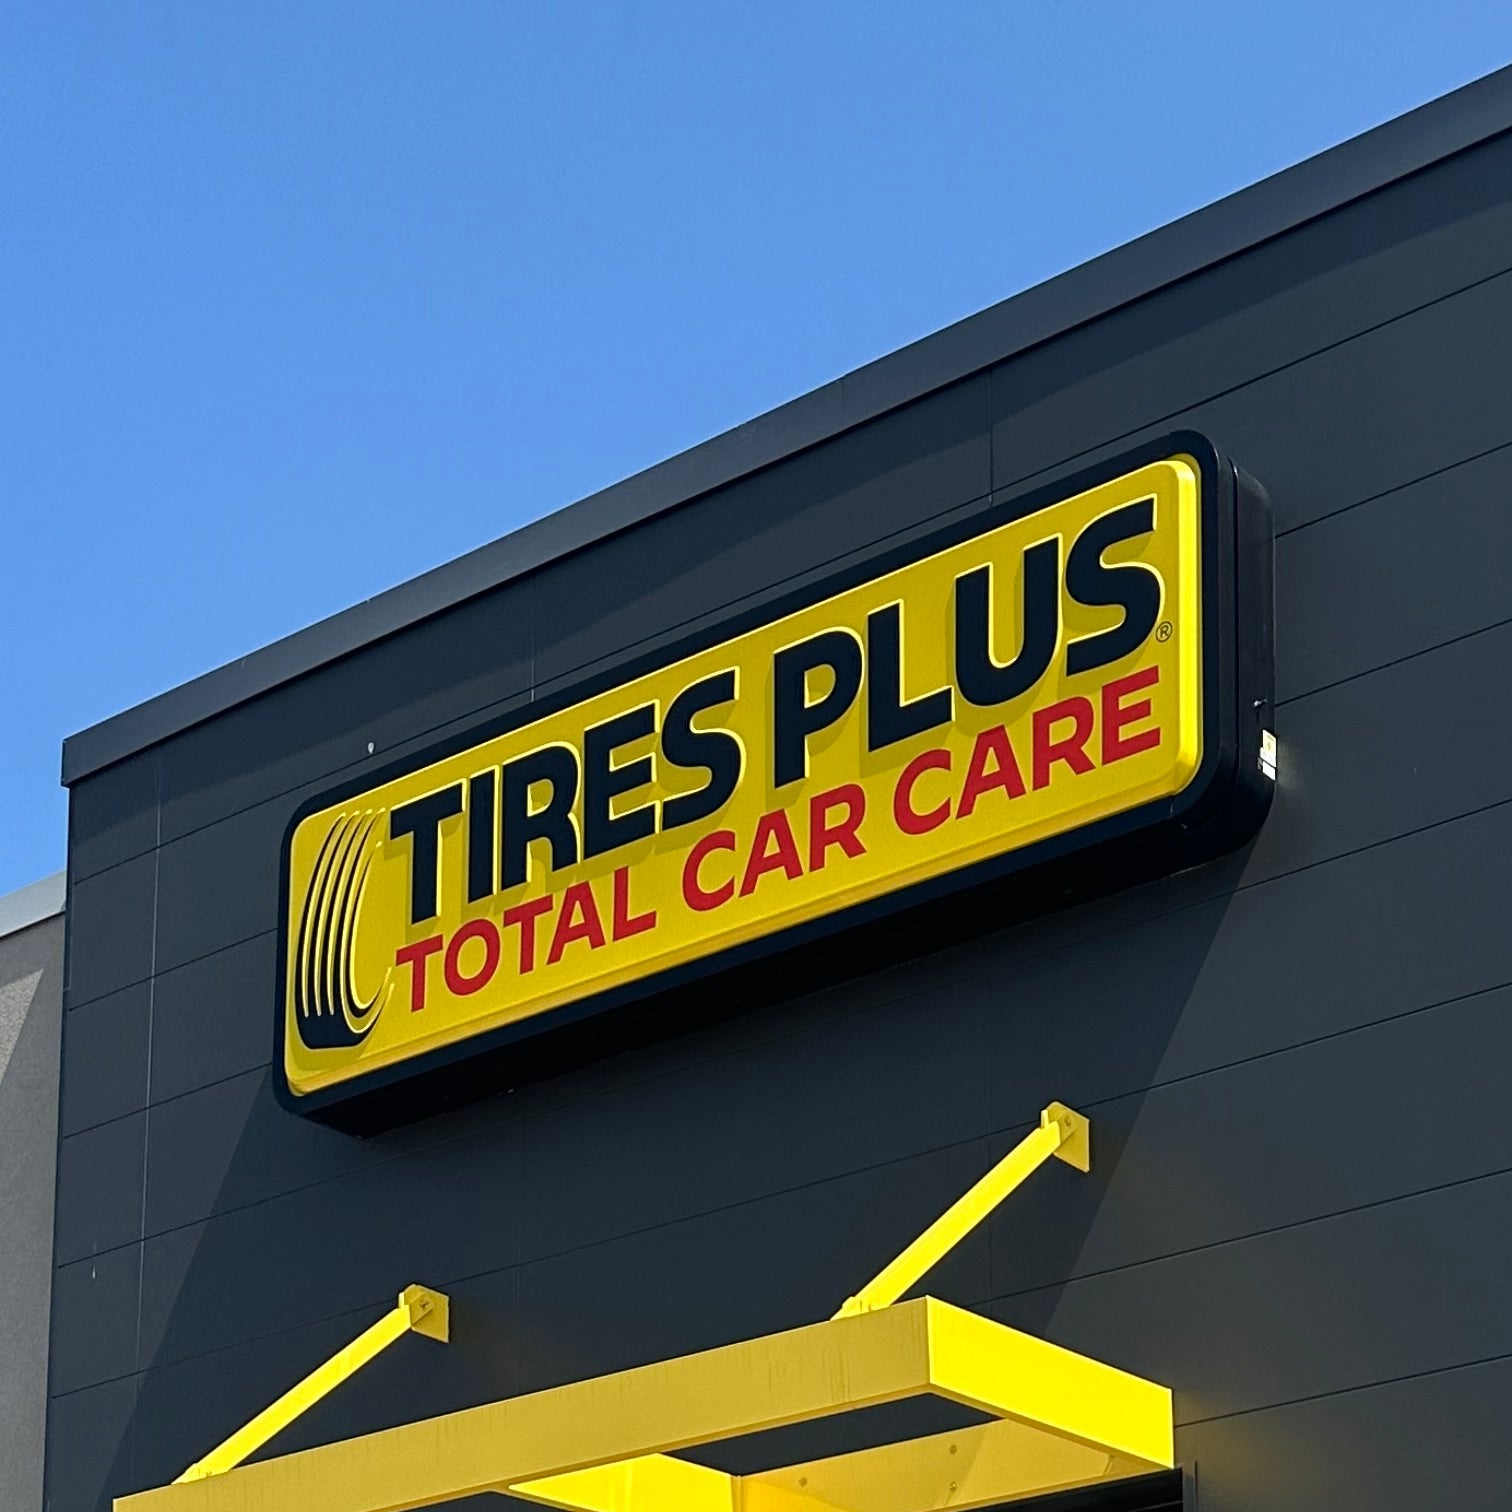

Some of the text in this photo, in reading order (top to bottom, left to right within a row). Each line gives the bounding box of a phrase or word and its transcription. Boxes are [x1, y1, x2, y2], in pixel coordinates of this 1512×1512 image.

[391, 667, 744, 922] TIRES
[396, 665, 1162, 1013] TOTAL CAR CARE
